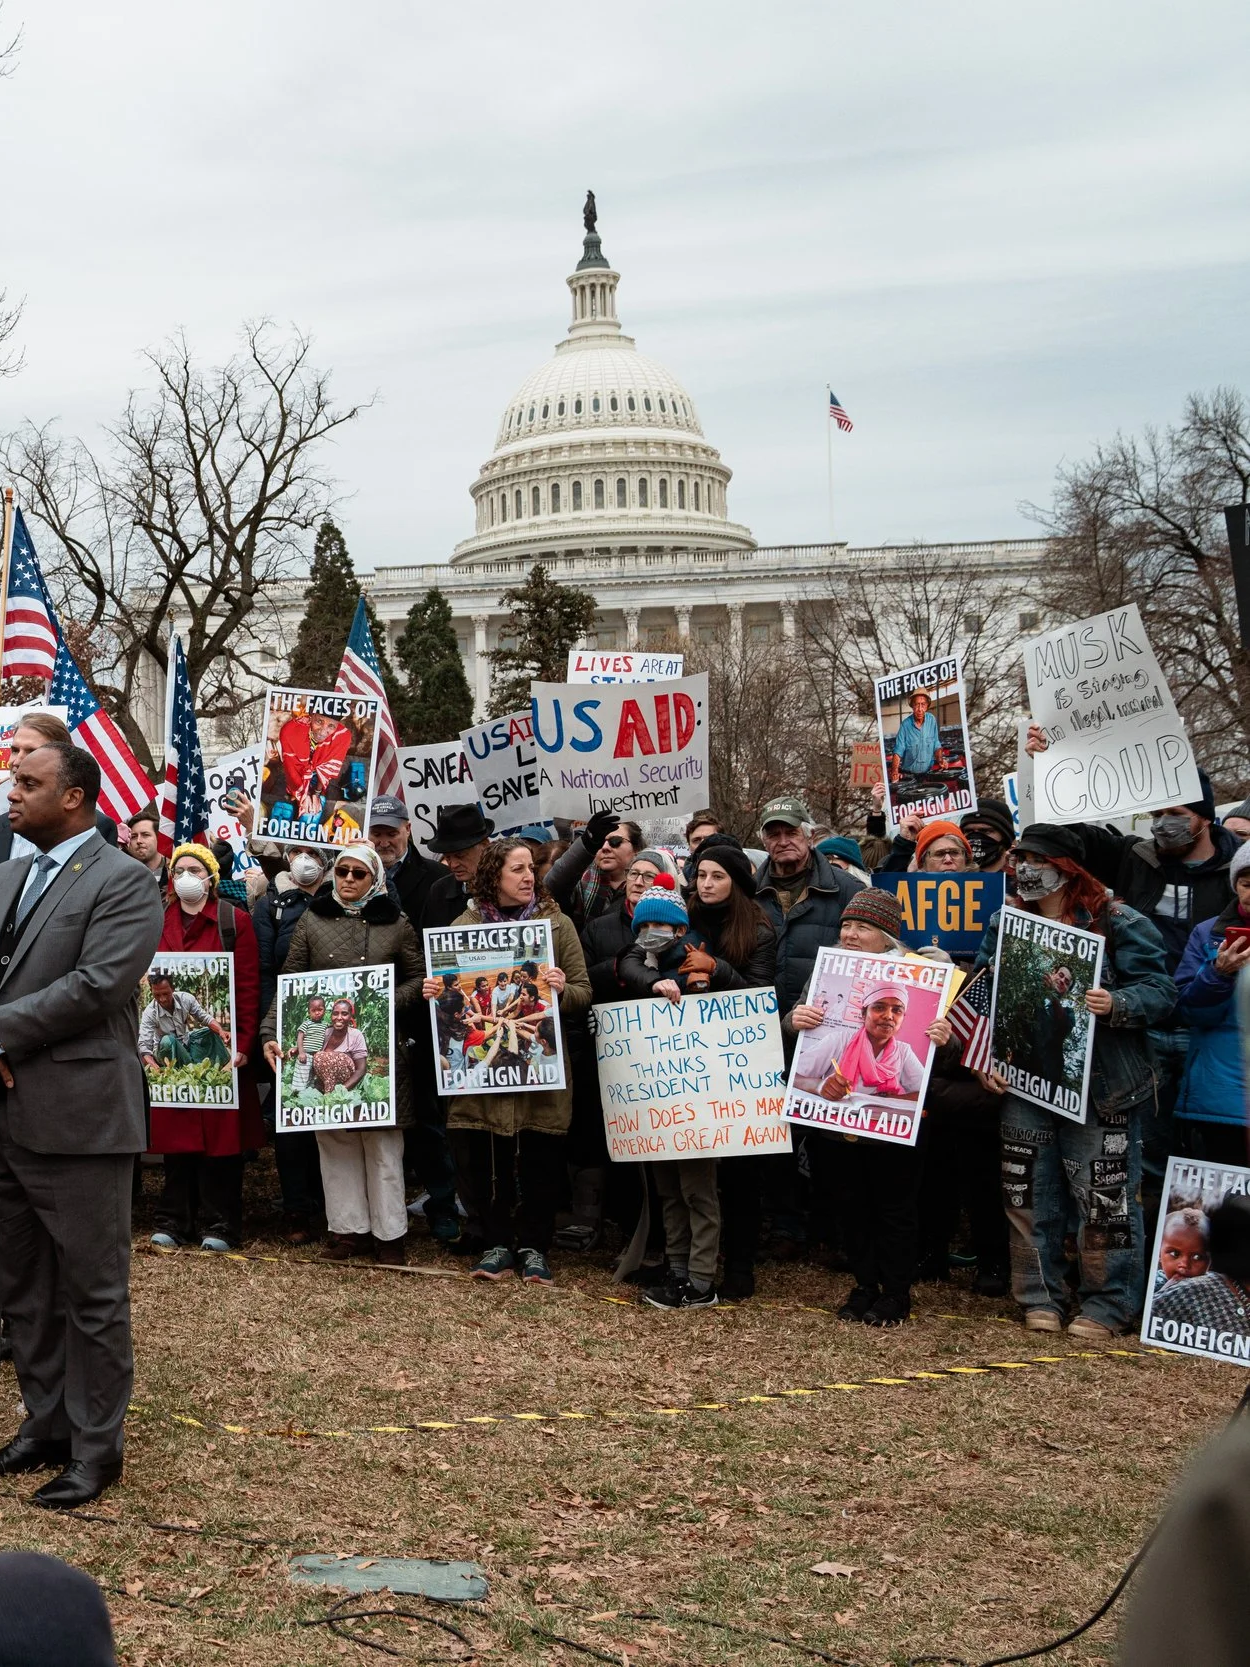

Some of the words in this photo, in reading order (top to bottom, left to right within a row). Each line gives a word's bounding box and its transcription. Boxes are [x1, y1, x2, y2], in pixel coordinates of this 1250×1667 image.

[575, 655, 633, 673] LIVES
[1035, 612, 1143, 687] MUSK
[878, 682, 901, 700] THE
[903, 666, 937, 693] FACES
[939, 660, 957, 681] OF
[272, 692, 302, 712] THE
[306, 697, 351, 717] FACES
[355, 701, 377, 719] OF
[468, 717, 534, 760] USAI
[854, 744, 881, 757] TOMO
[540, 767, 553, 787] A
[561, 767, 629, 789] National
[639, 755, 703, 783] Security
[1045, 734, 1189, 816] COUP
[482, 772, 540, 810] SAVE
[588, 785, 681, 815] Investment
[892, 795, 946, 824] FOREIGN
[949, 789, 971, 811] AID
[258, 818, 328, 843] FOREIGN
[896, 880, 984, 931] AFGE
[430, 933, 464, 952] THE
[468, 927, 519, 950] FACES
[522, 925, 545, 946] OF
[1004, 913, 1031, 940] THE
[1032, 922, 1075, 955] FACES
[1076, 938, 1099, 962] OF
[159, 958, 207, 976] FACES
[208, 958, 228, 976] OF
[283, 978, 313, 996] THE
[317, 972, 363, 995] FACES
[367, 968, 390, 989] OF
[823, 954, 858, 977] THE
[859, 959, 915, 985] FACES
[918, 967, 945, 989] OF
[594, 1005, 642, 1037] BOTH
[651, 1000, 686, 1029] MY
[697, 991, 779, 1024] PARENTS
[596, 1038, 632, 1061] LOST
[645, 1031, 708, 1054] THEIR
[718, 1023, 766, 1048] JOBS
[442, 1065, 521, 1089] FOREIGN
[526, 1064, 558, 1084] AID
[630, 1055, 706, 1079] THANKS
[719, 1052, 748, 1068] TO
[149, 1084, 200, 1103] REIGN
[204, 1085, 233, 1103] AID
[606, 1075, 711, 1105] PRESIDENT
[729, 1070, 786, 1092] MUSK
[991, 1057, 1051, 1102] FOREIGN
[1052, 1085, 1081, 1114] AID
[282, 1102, 355, 1126] FOREIGN
[358, 1101, 389, 1121] AID
[607, 1110, 639, 1135] HOW
[648, 1102, 696, 1130] DOES
[707, 1099, 746, 1120] THIS
[756, 1097, 785, 1116] MAK
[789, 1095, 872, 1129] FOREIGN
[875, 1111, 912, 1137] AID
[611, 1135, 666, 1157] AMERICA
[673, 1124, 734, 1152] GREAT
[743, 1124, 789, 1146] AGAIN
[1094, 1172, 1128, 1186] SABBATH
[1174, 1164, 1215, 1191] THE
[1149, 1316, 1250, 1358] FOREIGN
